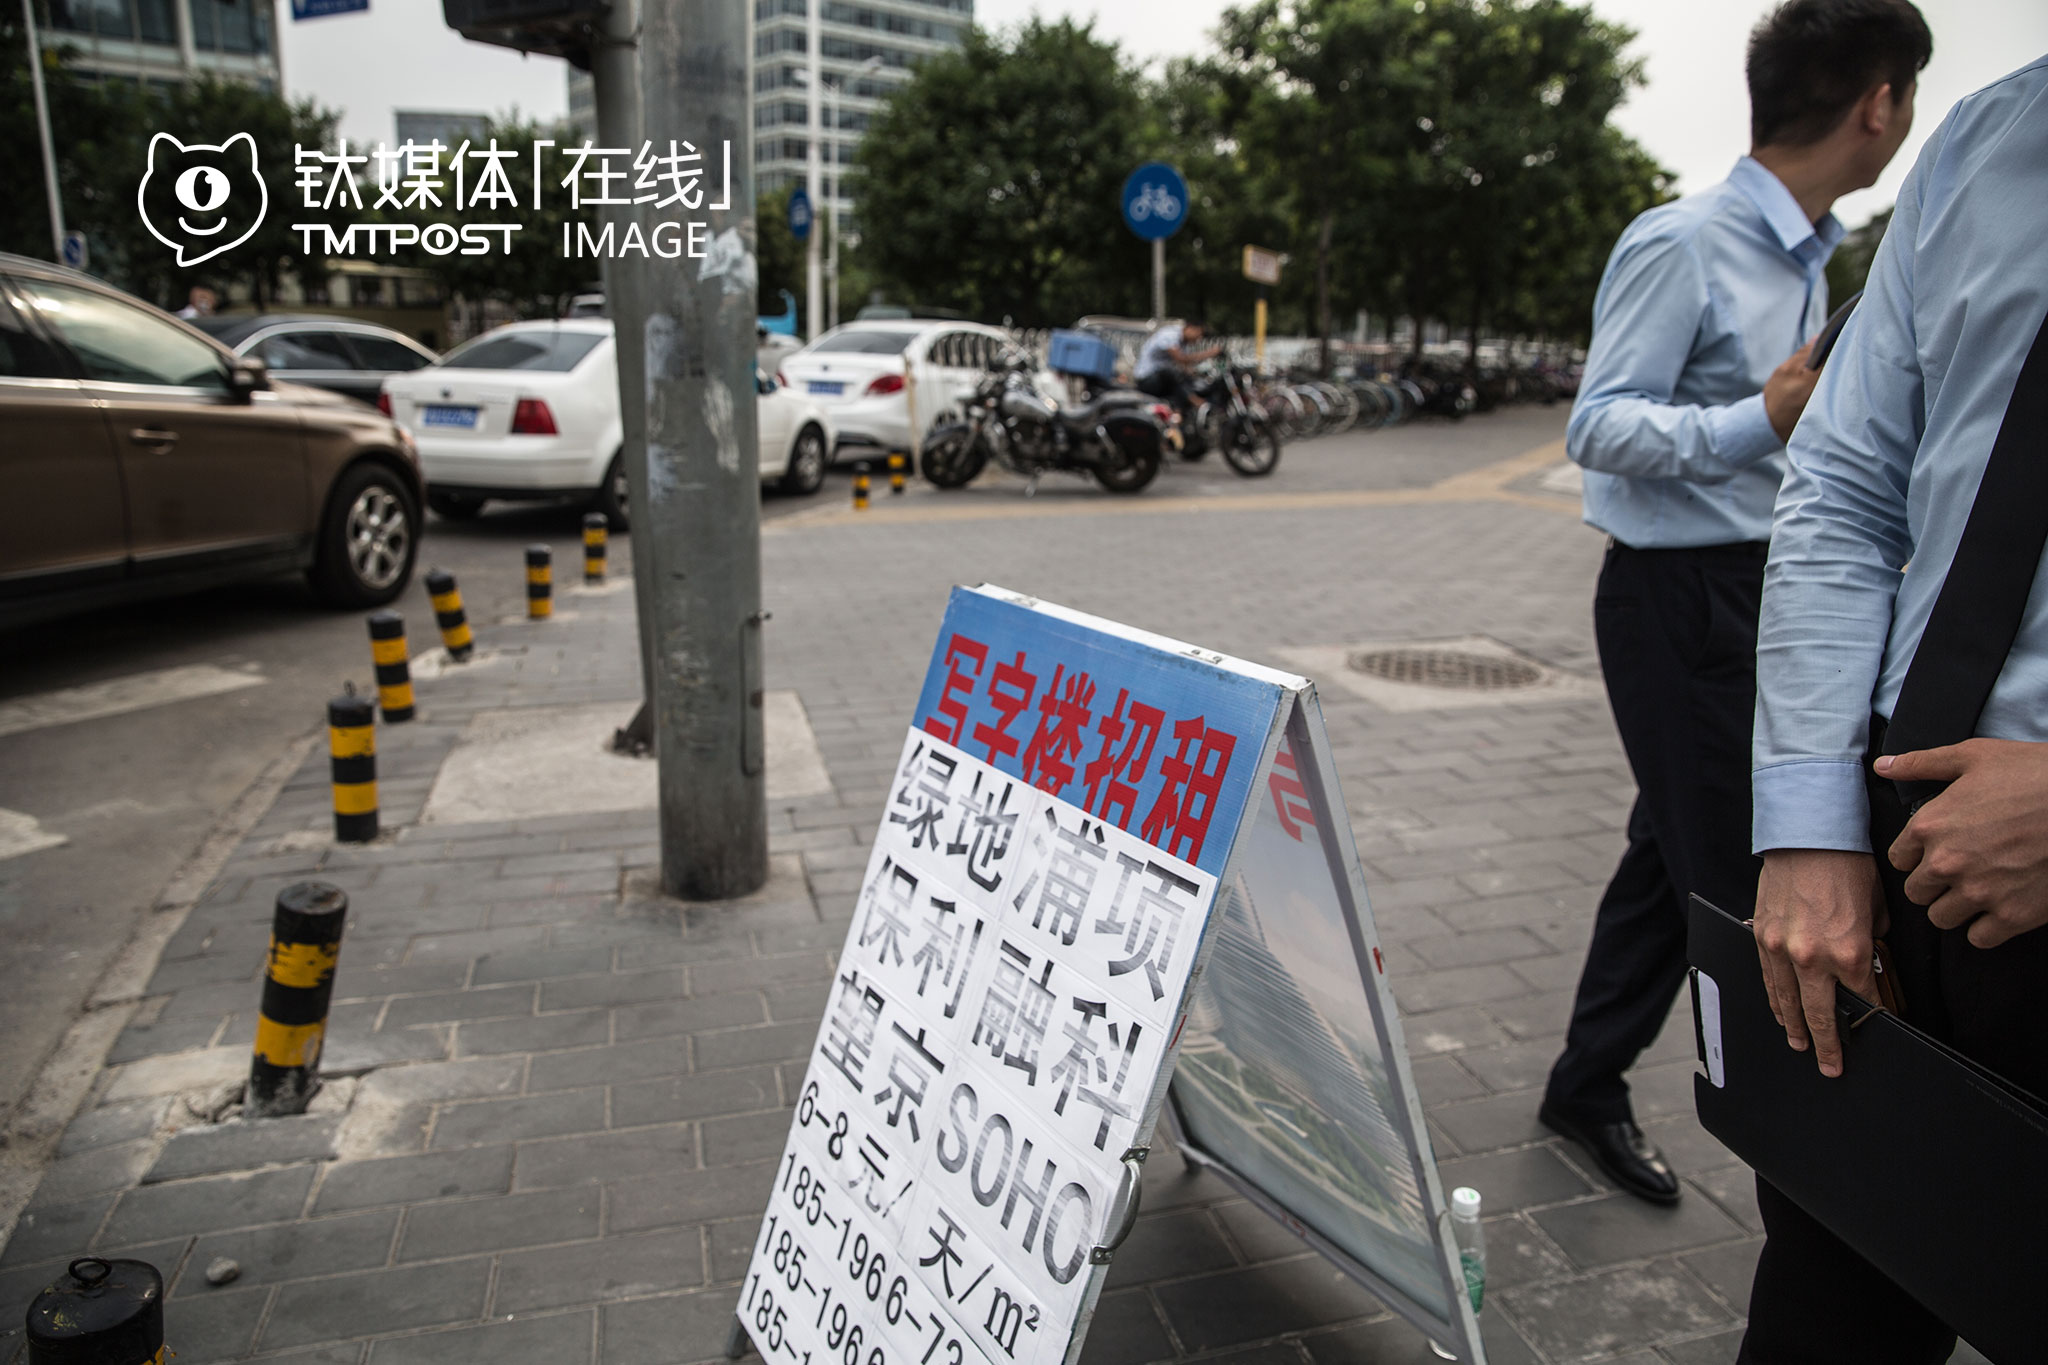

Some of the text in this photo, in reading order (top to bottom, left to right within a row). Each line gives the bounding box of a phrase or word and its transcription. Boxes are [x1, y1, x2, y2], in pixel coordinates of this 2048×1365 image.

[889, 739, 1201, 1002] 绿地 浦项
[923, 632, 1238, 867] 写字楼招租
[820, 969, 1093, 1285] 望京 SOHO
[857, 854, 1143, 1152] 保利 融科
[747, 1273, 812, 1365] 185-
